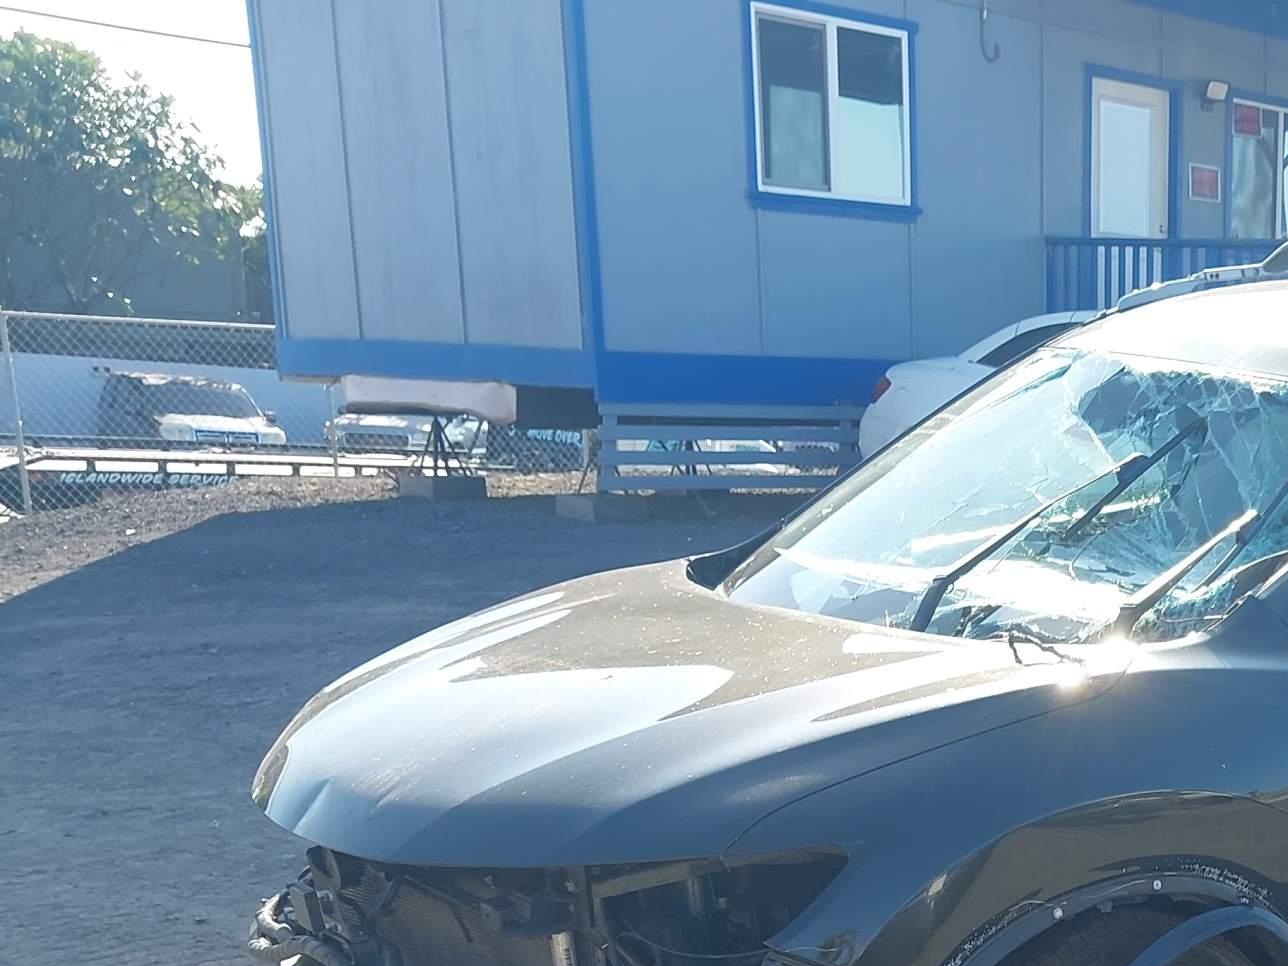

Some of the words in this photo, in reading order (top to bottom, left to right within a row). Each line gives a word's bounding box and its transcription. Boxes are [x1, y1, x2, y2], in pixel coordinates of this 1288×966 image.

[526, 428, 555, 441] MOVE
[555, 429, 582, 445] OVER
[60, 472, 164, 485] ISLANDWIDE
